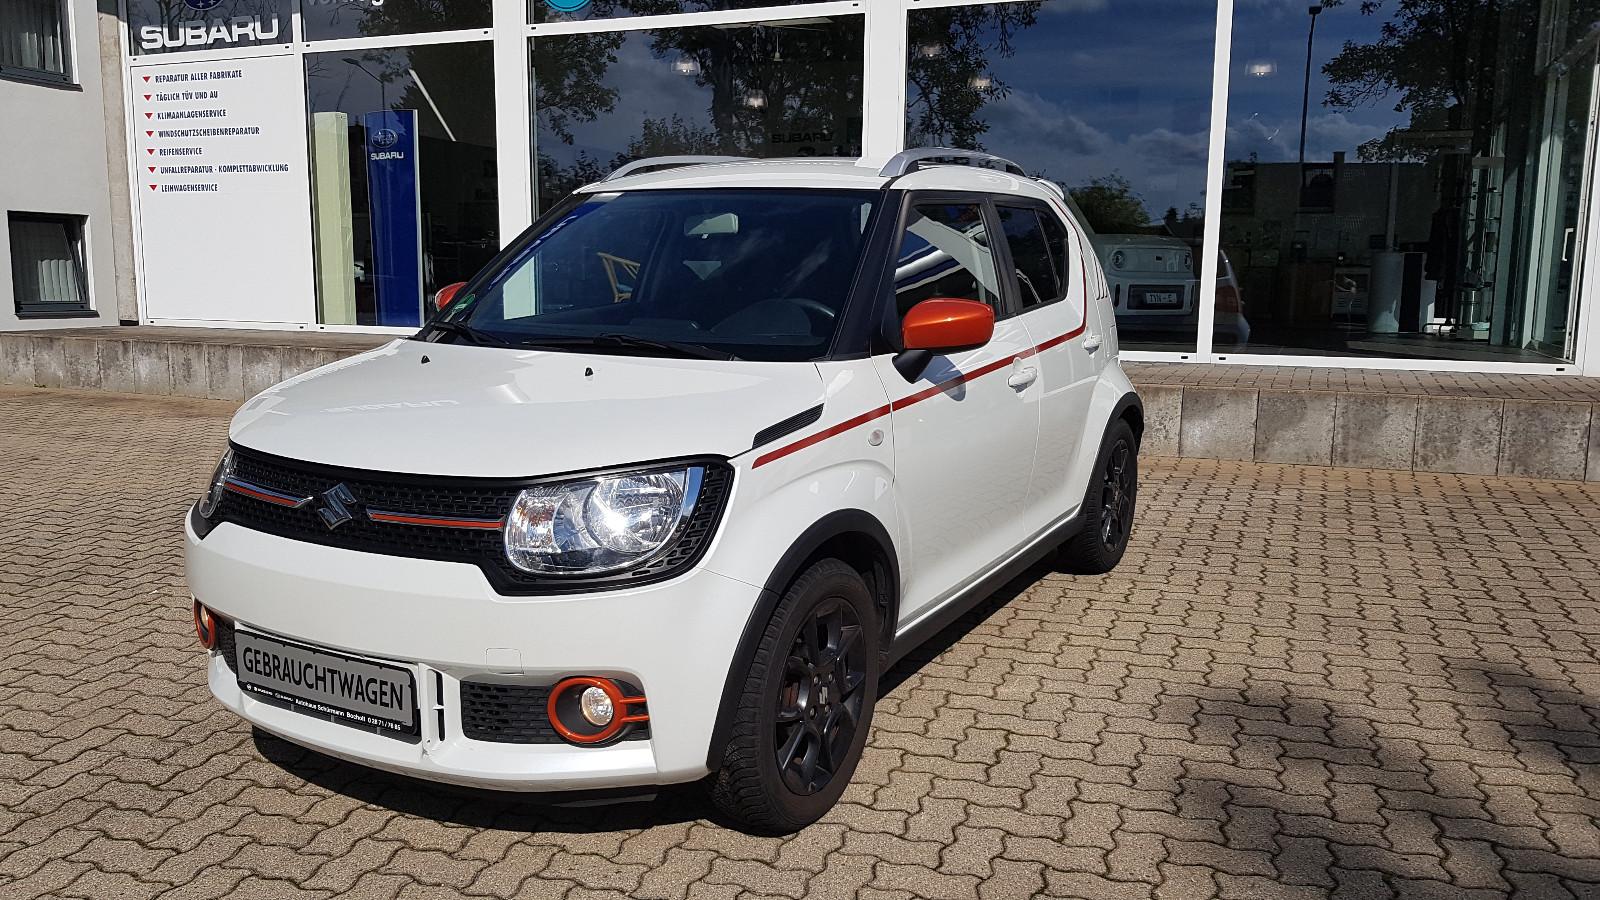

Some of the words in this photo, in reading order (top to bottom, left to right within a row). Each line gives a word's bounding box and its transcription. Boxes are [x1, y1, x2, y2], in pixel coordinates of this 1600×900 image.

[140, 13, 280, 50] SUBARU
[155, 73, 189, 83] REPARATUR
[190, 72, 208, 81] ALLER
[209, 69, 242, 80] FABRIKATE
[156, 91, 180, 101] TÄGLICH
[182, 90, 193, 100] TÜV
[195, 91, 208, 100] UND
[209, 90, 218, 99] AU
[157, 109, 226, 120] KLIMAANLAGENSERVICE
[158, 126, 260, 138] WINDSCHUTZSCHEIBENREPARATUR
[159, 147, 203, 156] REIFENSERVICE
[370, 151, 404, 160] SUBARU
[160, 165, 213, 174] UNFALLREPARATUR
[218, 163, 289, 173] KOMPLETTABWICKLUNG
[161, 183, 218, 193] LEIHWAGENSERVICE
[242, 646, 404, 711] GEBRAUCHTWAGEN
[346, 711, 366, 722] Bocholt
